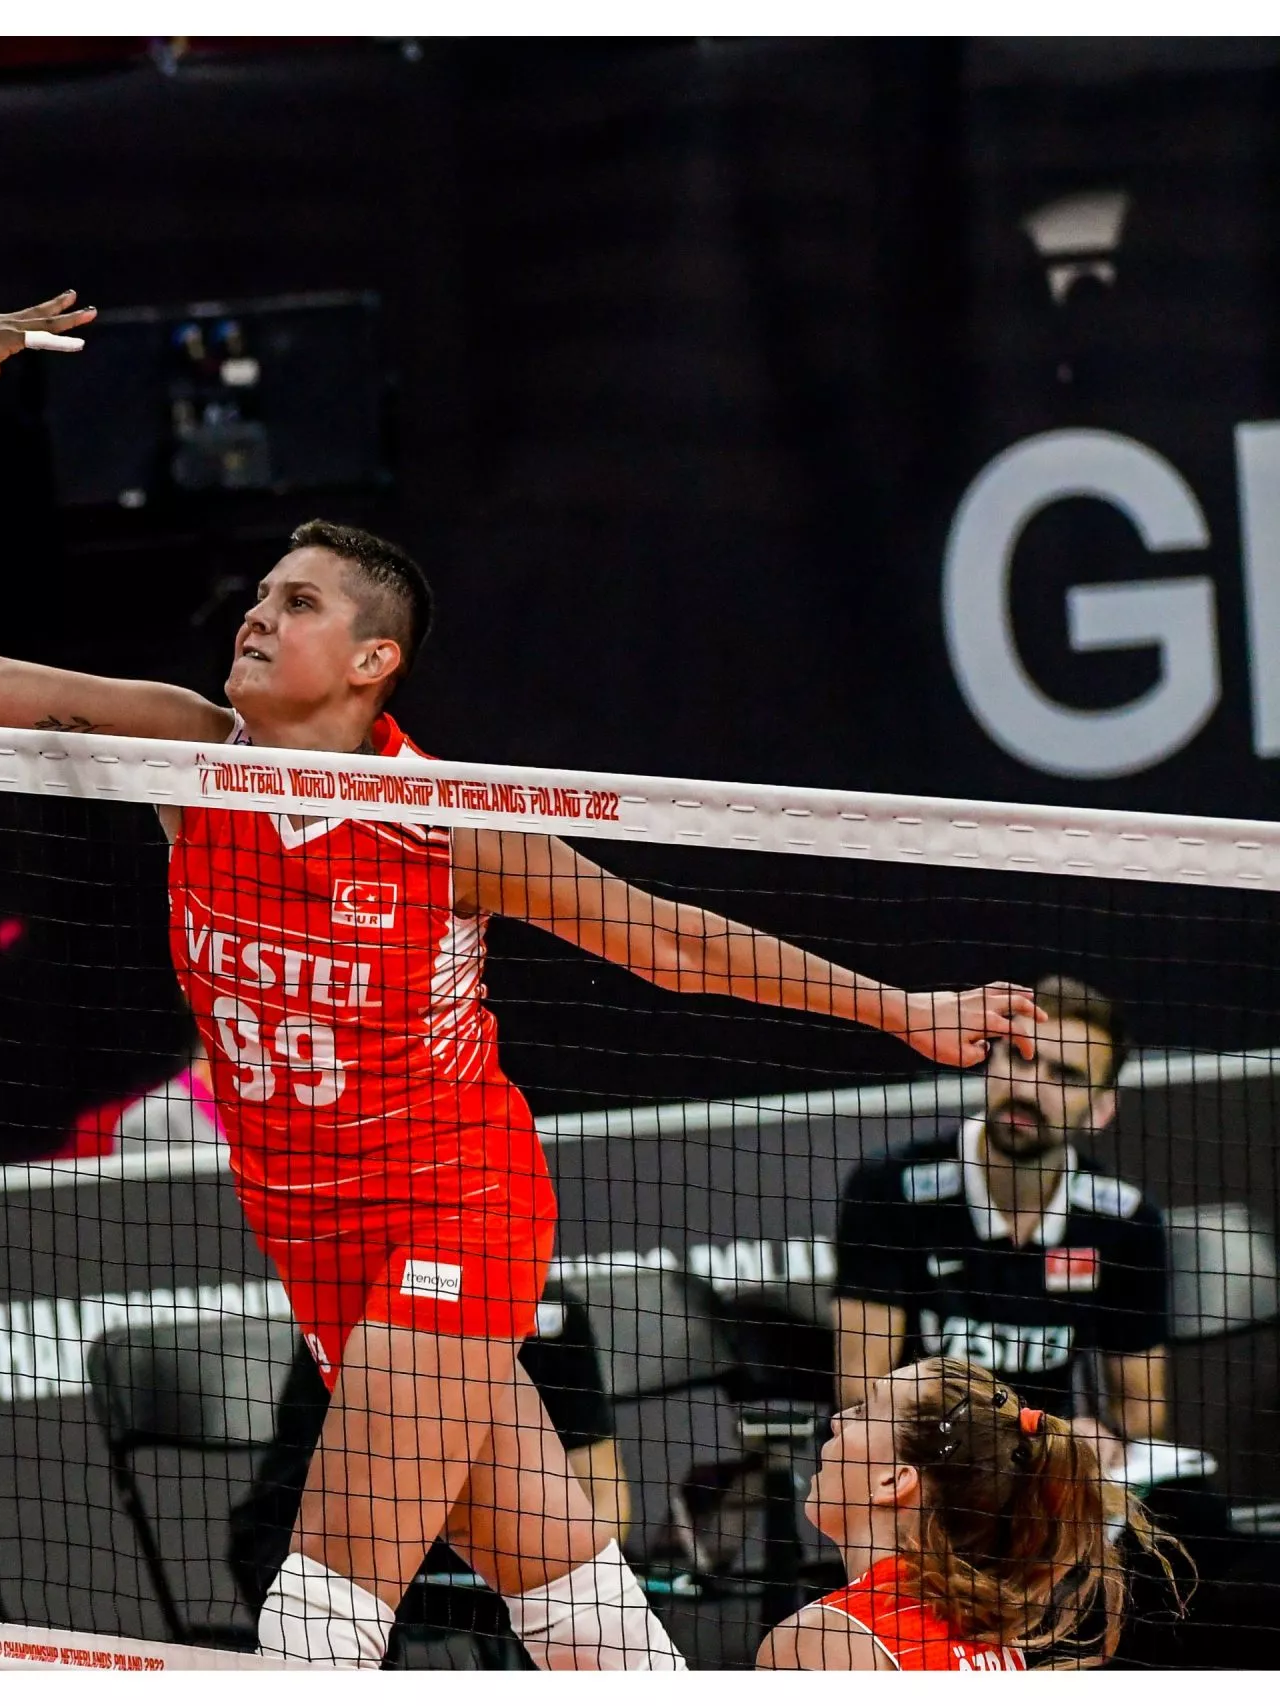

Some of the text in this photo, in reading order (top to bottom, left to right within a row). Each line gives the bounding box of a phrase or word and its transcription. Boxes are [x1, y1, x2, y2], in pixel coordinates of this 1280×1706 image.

[942, 421, 1280, 780] G
[212, 762, 620, 821] VOLLEYBALL WORLD CHAMPIONSHIP NETHERLANDS POLAND 2022
[184, 904, 383, 1008] VESTEL
[344, 913, 379, 926] TUR
[212, 996, 346, 1107] 99
[405, 1270, 459, 1290] trendyol
